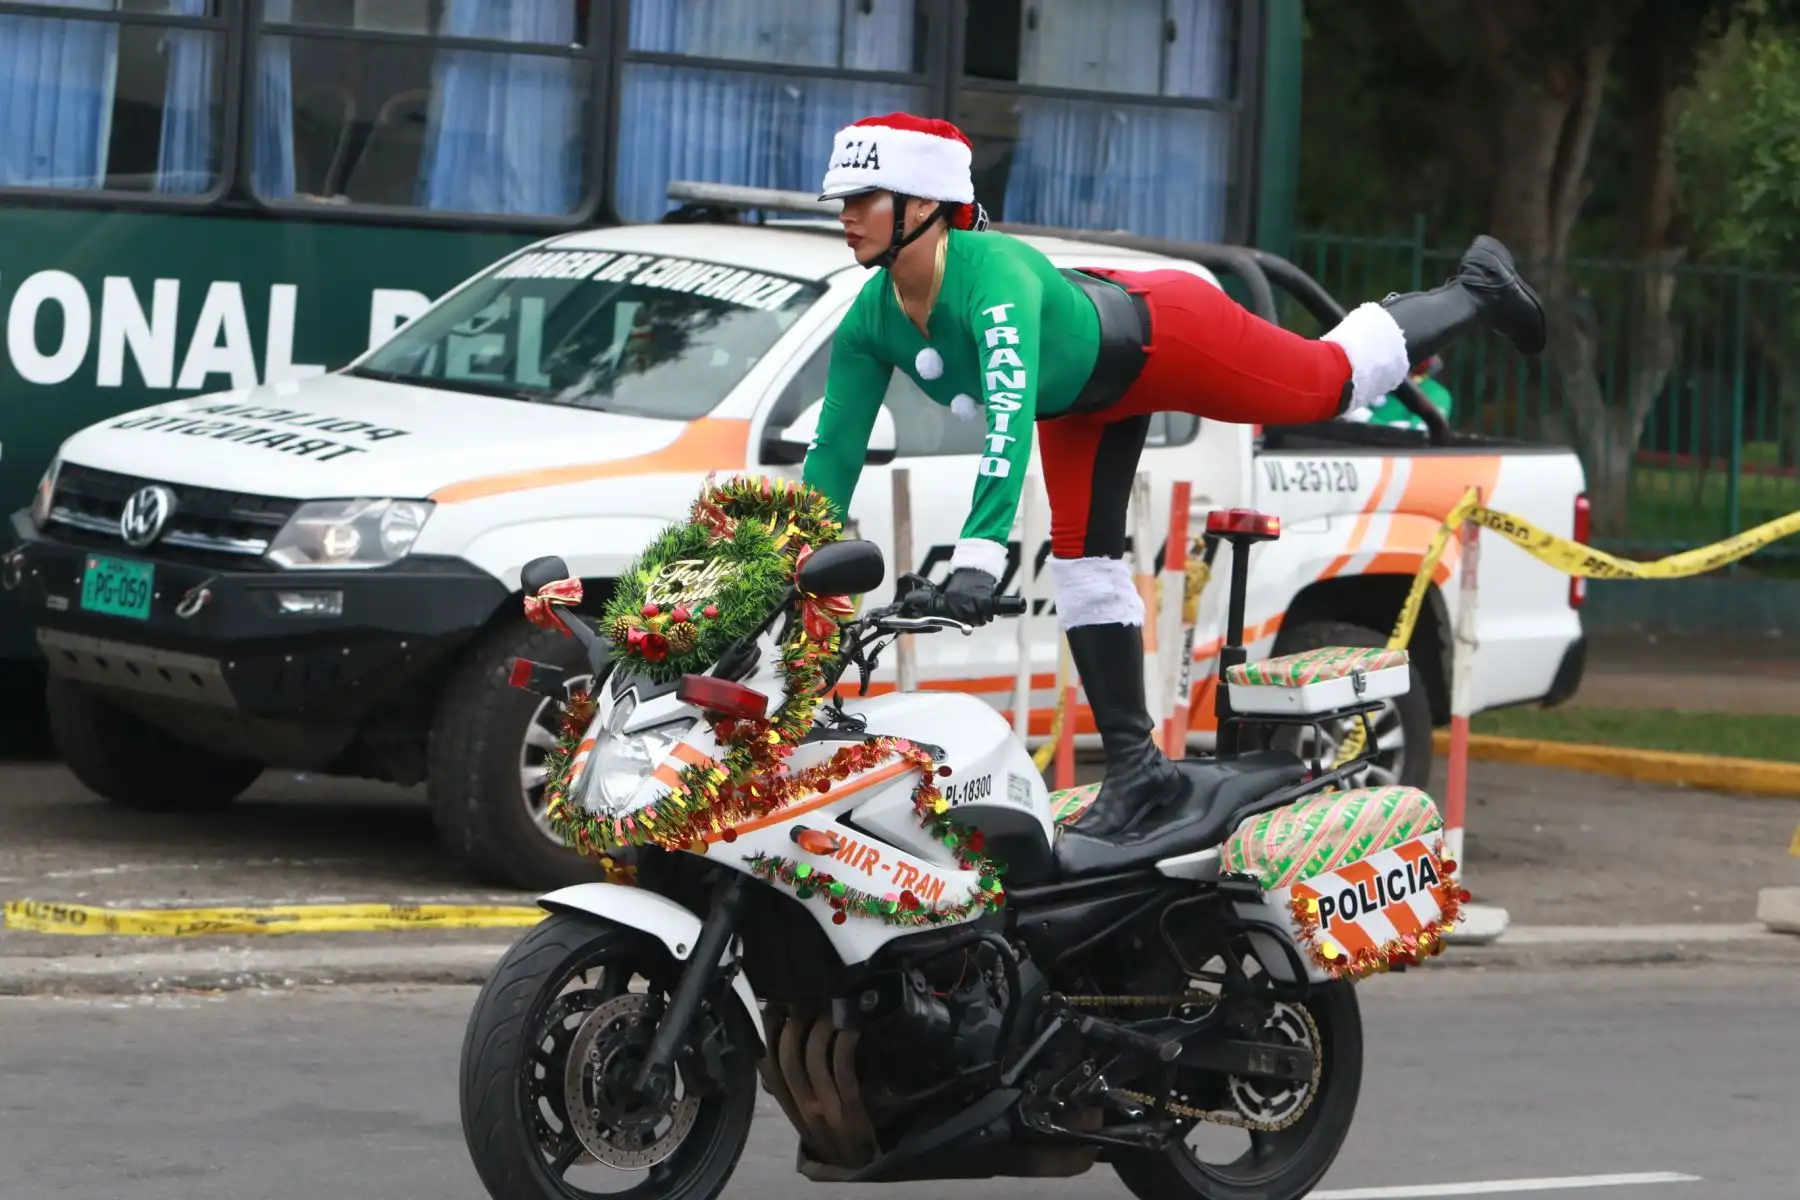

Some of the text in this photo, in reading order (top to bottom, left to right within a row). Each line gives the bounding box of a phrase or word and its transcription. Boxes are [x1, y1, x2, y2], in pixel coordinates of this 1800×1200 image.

[834, 141, 881, 170] CIA
[593, 253, 654, 282] DE
[630, 257, 804, 311] CONFIANZA
[0, 269, 326, 389] ONAL
[979, 302, 1028, 479] TRANSITO
[1265, 461, 1359, 492] VL-25120
[945, 773, 992, 807] PL-18300
[1318, 857, 1440, 929] POLICIA
